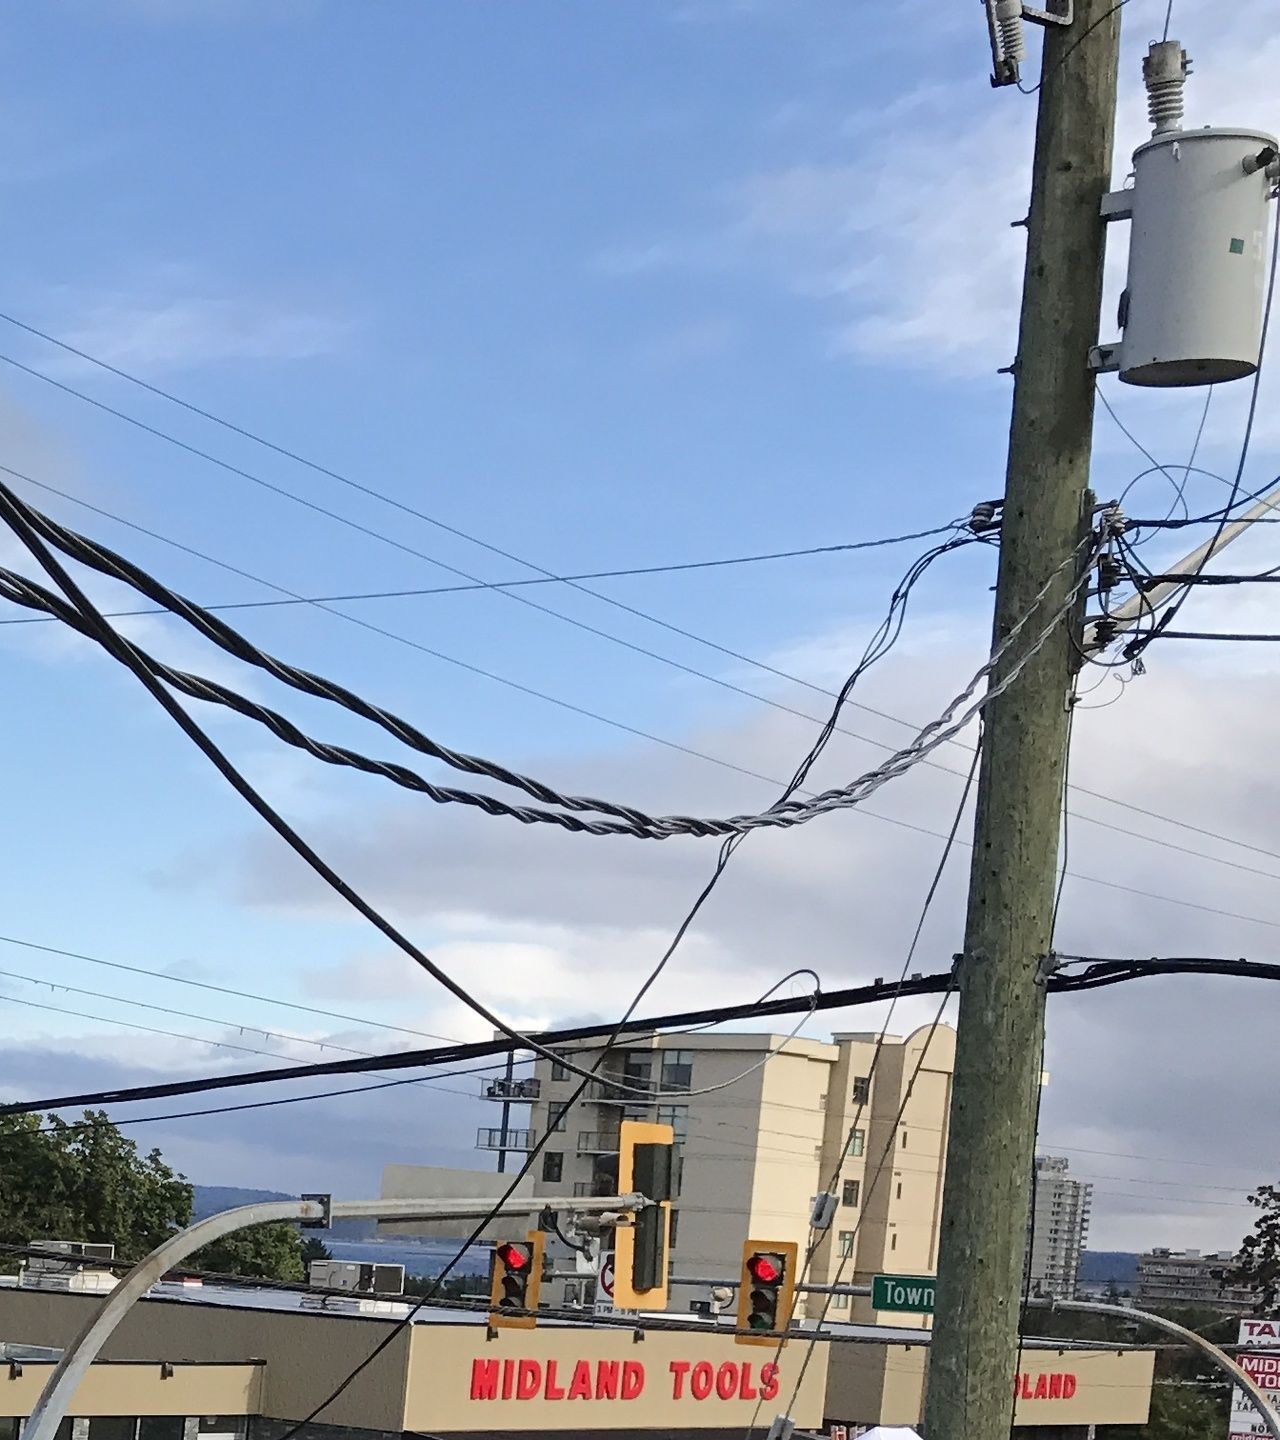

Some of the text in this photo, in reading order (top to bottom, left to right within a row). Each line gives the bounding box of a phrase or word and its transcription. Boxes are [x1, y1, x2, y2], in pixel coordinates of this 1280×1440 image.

[1244, 1322, 1280, 1338] TA
[1242, 1357, 1280, 1374] MID
[470, 1358, 780, 1400] MIDLAND TOOLS
[1254, 1373, 1280, 1388] TO
